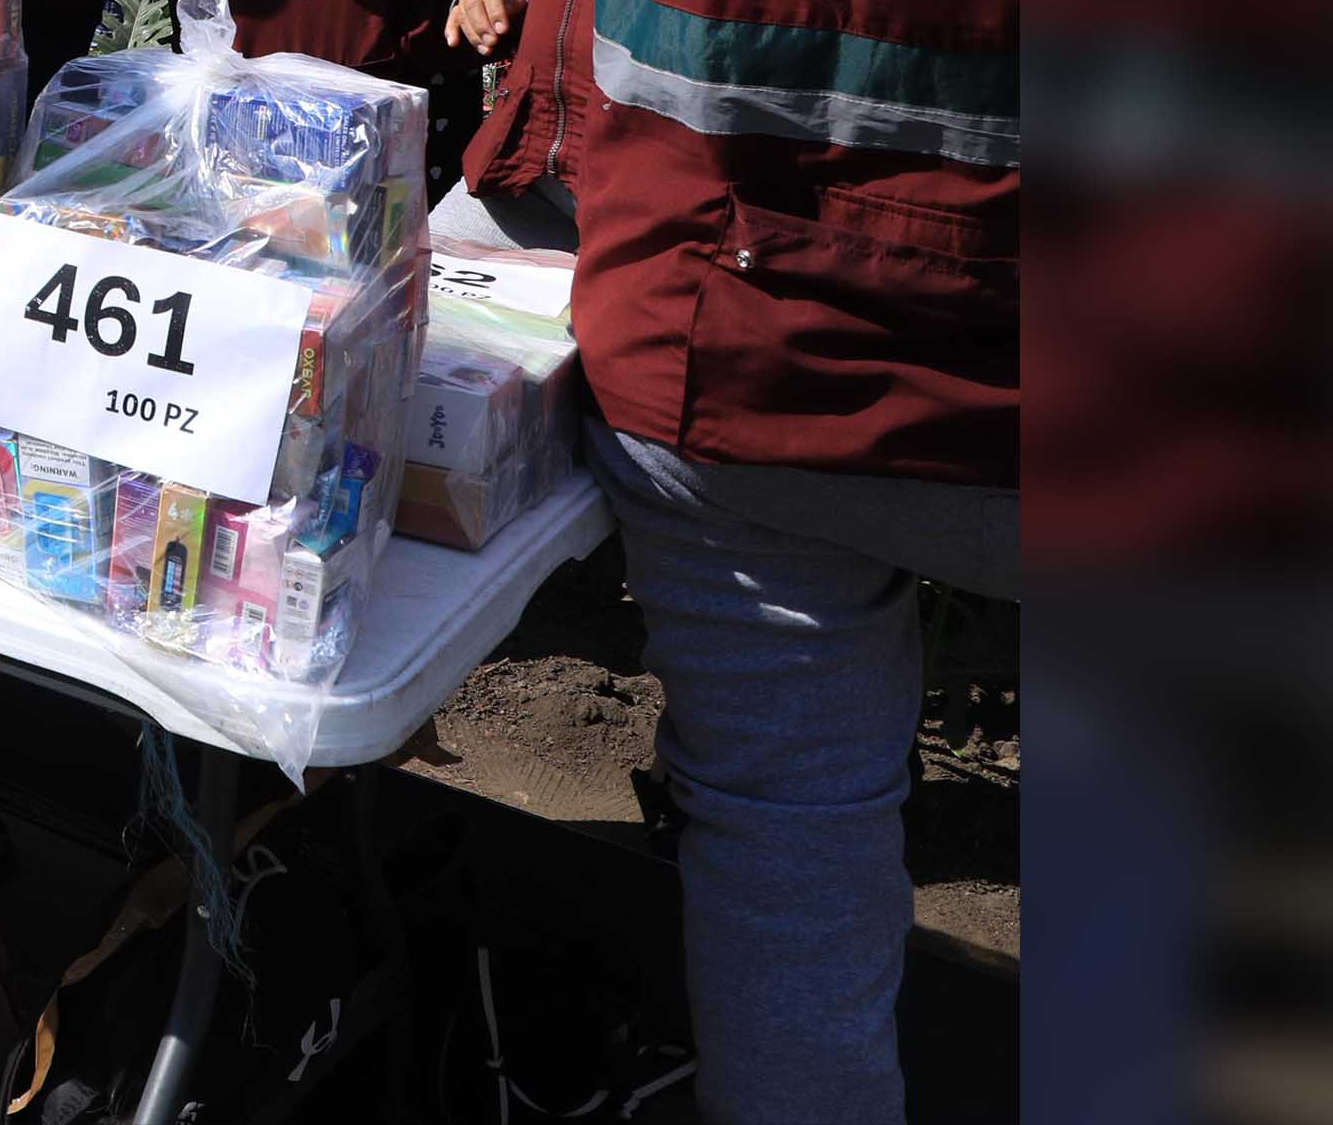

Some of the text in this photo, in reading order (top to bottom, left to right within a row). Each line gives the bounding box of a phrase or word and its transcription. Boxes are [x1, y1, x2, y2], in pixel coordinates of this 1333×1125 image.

[430, 263, 496, 288] 62
[24, 263, 194, 376] 461
[105, 389, 199, 434] 100 PZ
